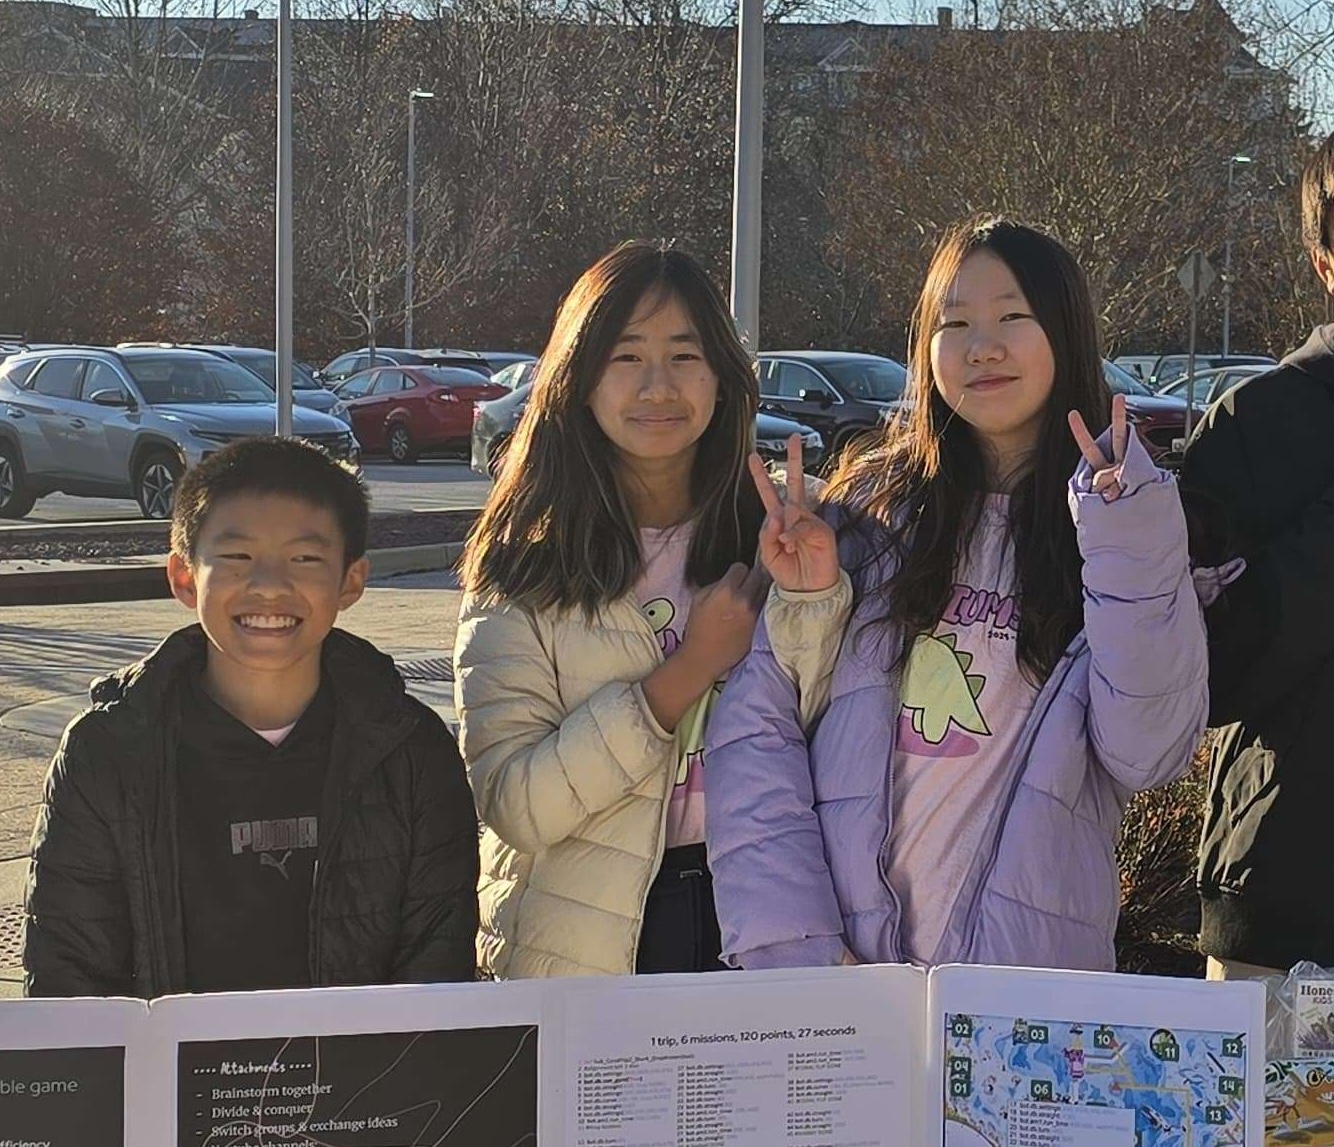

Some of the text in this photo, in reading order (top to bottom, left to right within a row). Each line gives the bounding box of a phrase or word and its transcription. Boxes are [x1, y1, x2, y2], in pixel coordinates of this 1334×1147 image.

[954, 1023, 969, 1034] 02
[651, 1025, 856, 1047] 1 trip, 6 missions, 120 points, 27 seconds
[1030, 1030, 1045, 1040] 03
[1097, 1034, 1110, 1045] 10
[1164, 1047, 1175, 1058] 11
[1226, 1042, 1239, 1054] 12
[220, 1062, 286, 1076] Attachments
[954, 1061, 968, 1072] 04
[30, 1080, 78, 1097] game
[212, 1083, 332, 1100] Brainstorm together
[954, 1082, 967, 1093] 01
[1033, 1083, 1049, 1095] 06
[1222, 1080, 1235, 1092] 14
[212, 1104, 314, 1119] Divide & conquer
[1209, 1109, 1222, 1121] 13
[211, 1117, 398, 1138] Switch groups & exchange ideas
